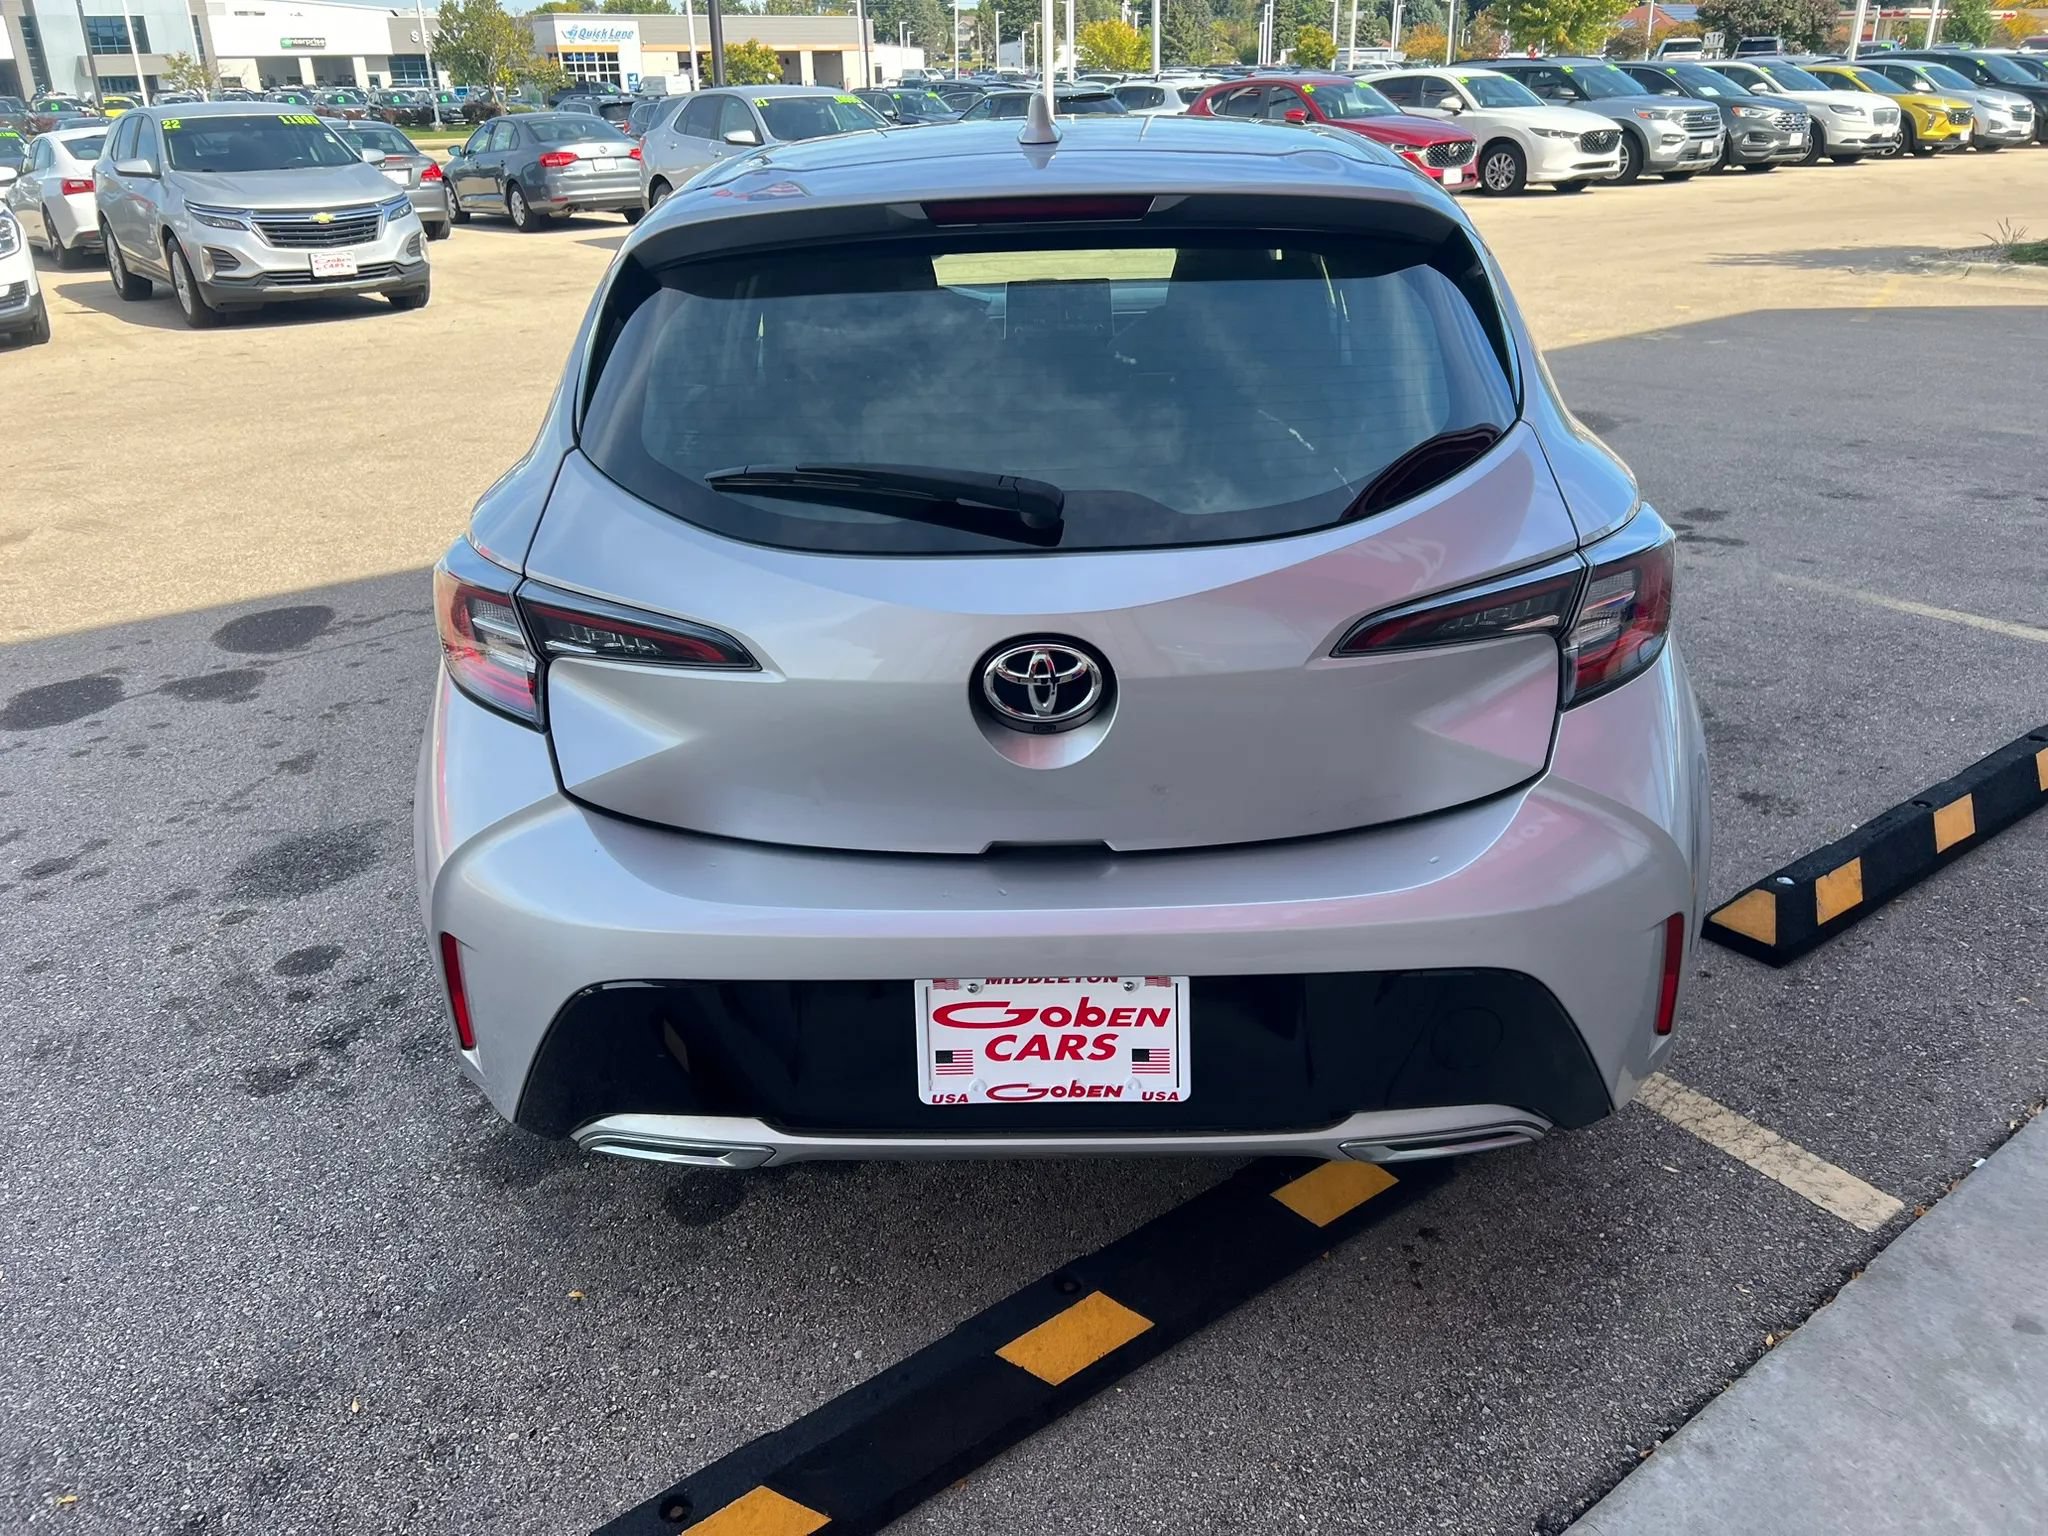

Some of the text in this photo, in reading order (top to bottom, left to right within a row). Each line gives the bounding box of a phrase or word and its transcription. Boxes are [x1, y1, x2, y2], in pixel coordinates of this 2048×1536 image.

[579, 27, 634, 39] Quick Lane
[162, 119, 181, 130] 22
[985, 976, 1119, 985] MIDDLETON
[985, 1033, 1119, 1061] CARS
[931, 1093, 969, 1104] USA
[1141, 1091, 1179, 1102] USA
